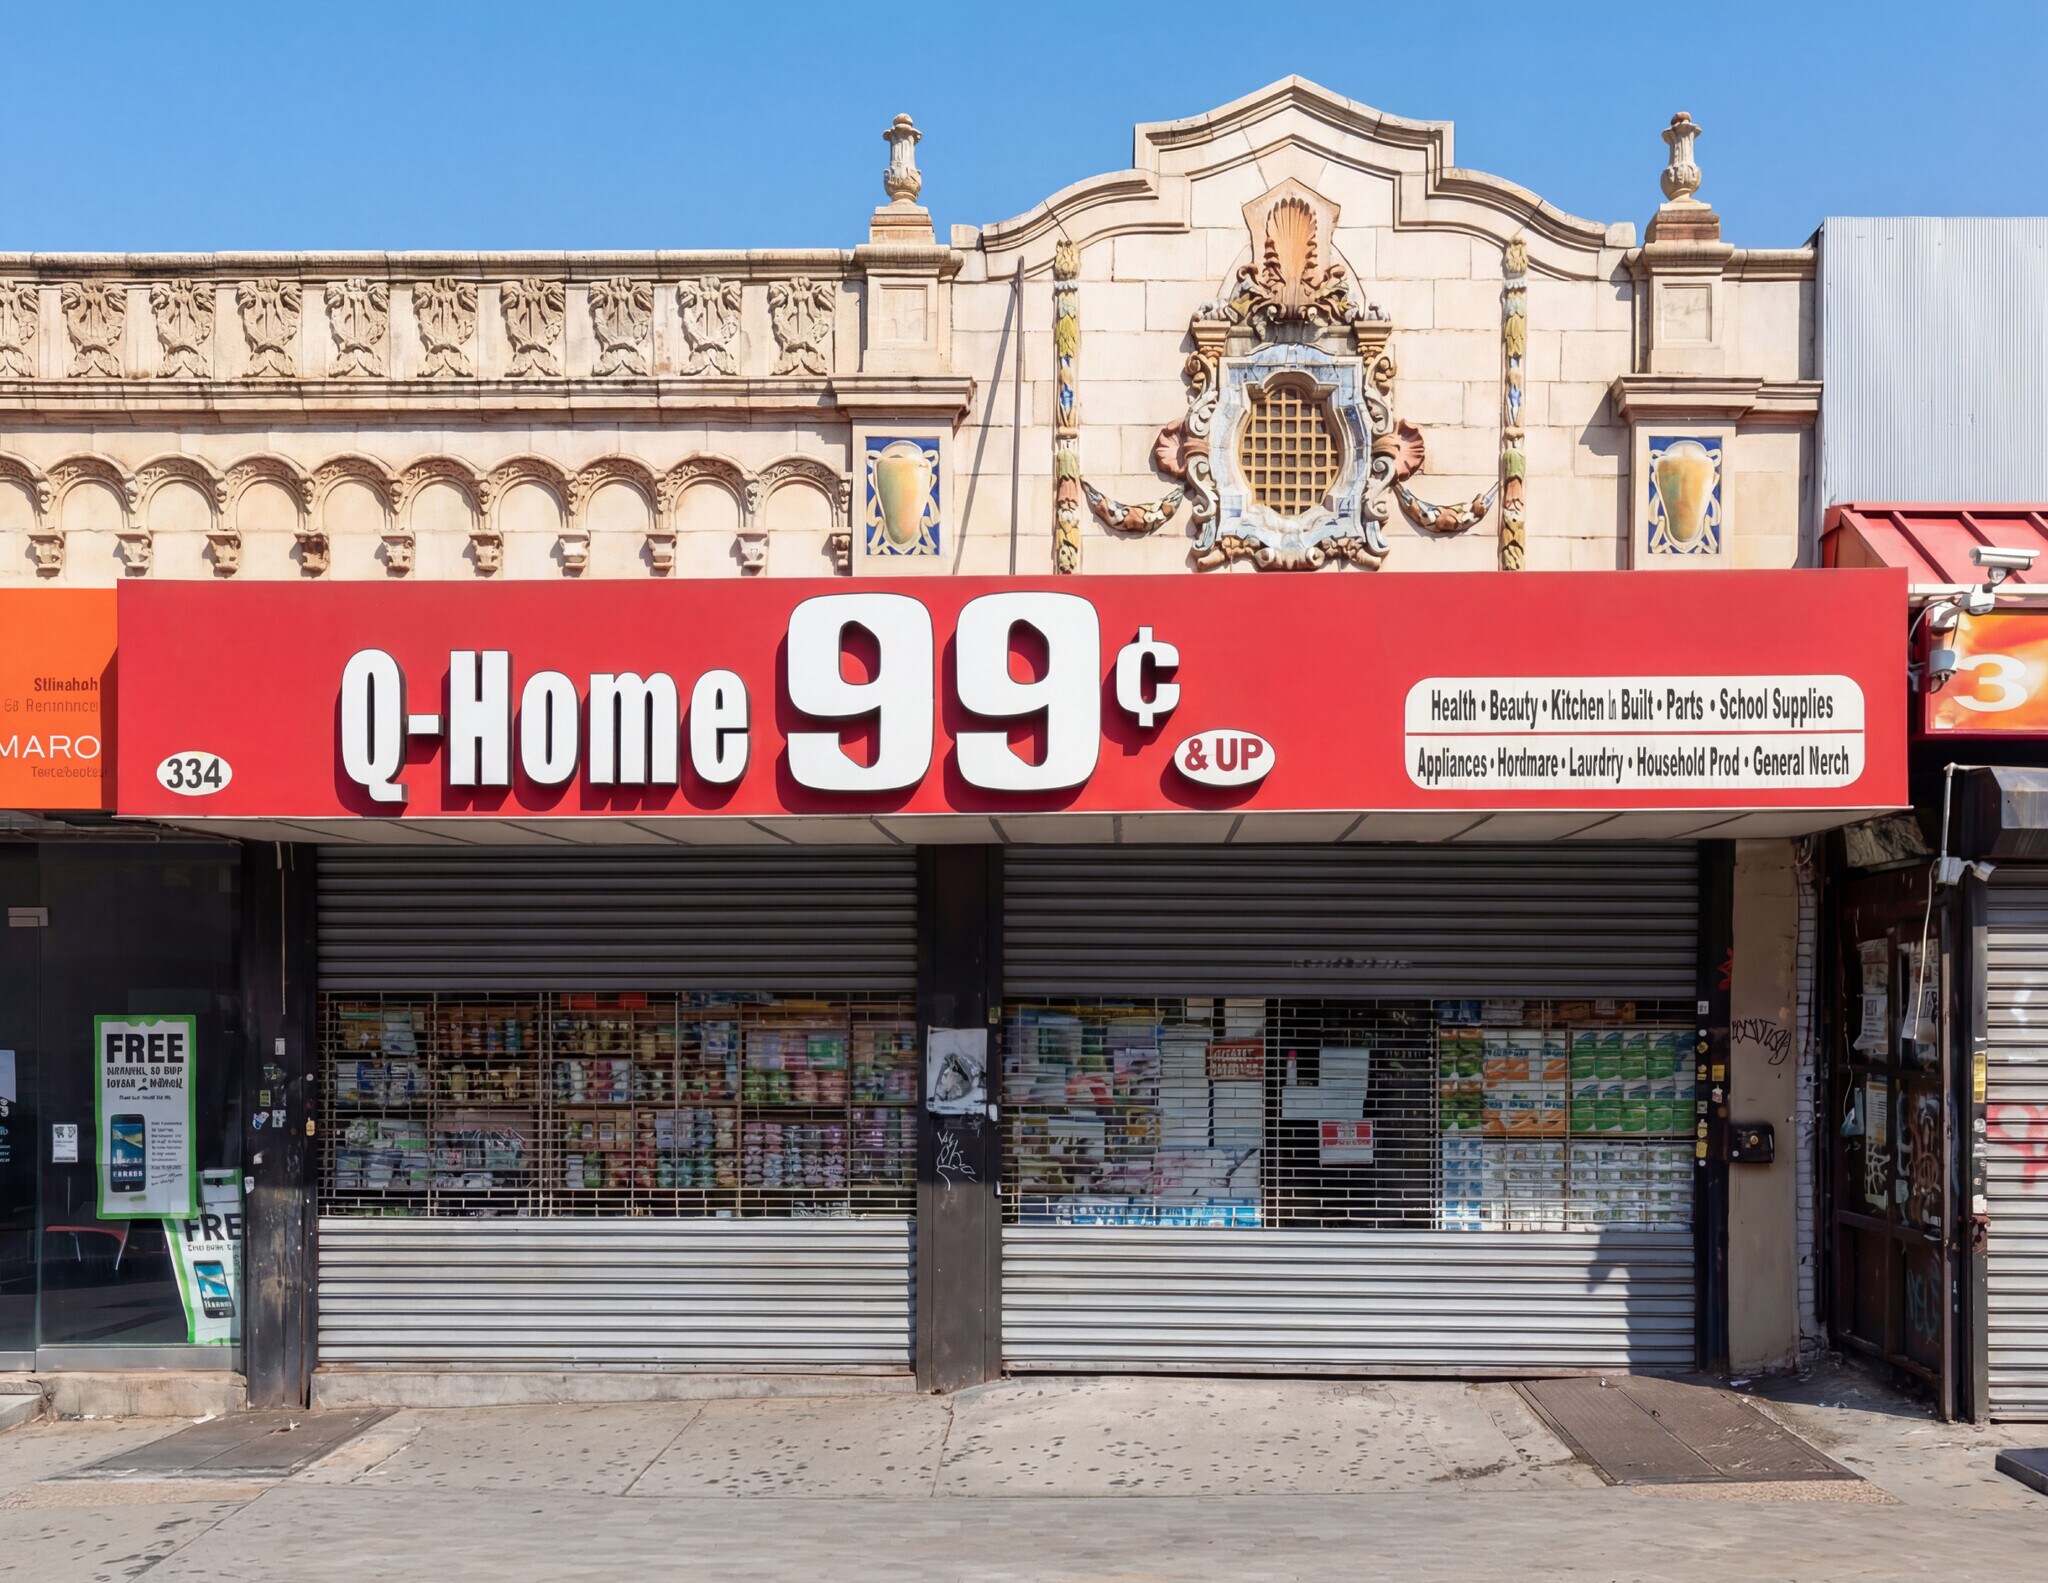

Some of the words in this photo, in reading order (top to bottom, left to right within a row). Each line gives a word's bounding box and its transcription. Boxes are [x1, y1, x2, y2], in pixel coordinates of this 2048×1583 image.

[1953, 654, 2028, 712] 3
[341, 648, 750, 803] Q-Home
[1431, 689, 1476, 721] Health
[1490, 689, 1538, 730] Beauty
[1551, 688, 1604, 721] Kitchen
[1621, 688, 1653, 720] Built
[1666, 688, 1703, 720] Parts
[1720, 688, 1767, 720] School
[1773, 687, 1833, 728] Supplies
[0, 734, 101, 759] MARO
[1184, 738, 1209, 772] &
[1215, 737, 1264, 771] UP
[1417, 747, 1487, 785] Appliances
[1637, 746, 1705, 776] Household
[1710, 746, 1739, 776] Prod
[1754, 745, 1804, 776] General
[165, 757, 222, 790] 334
[106, 1033, 184, 1063] FREE
